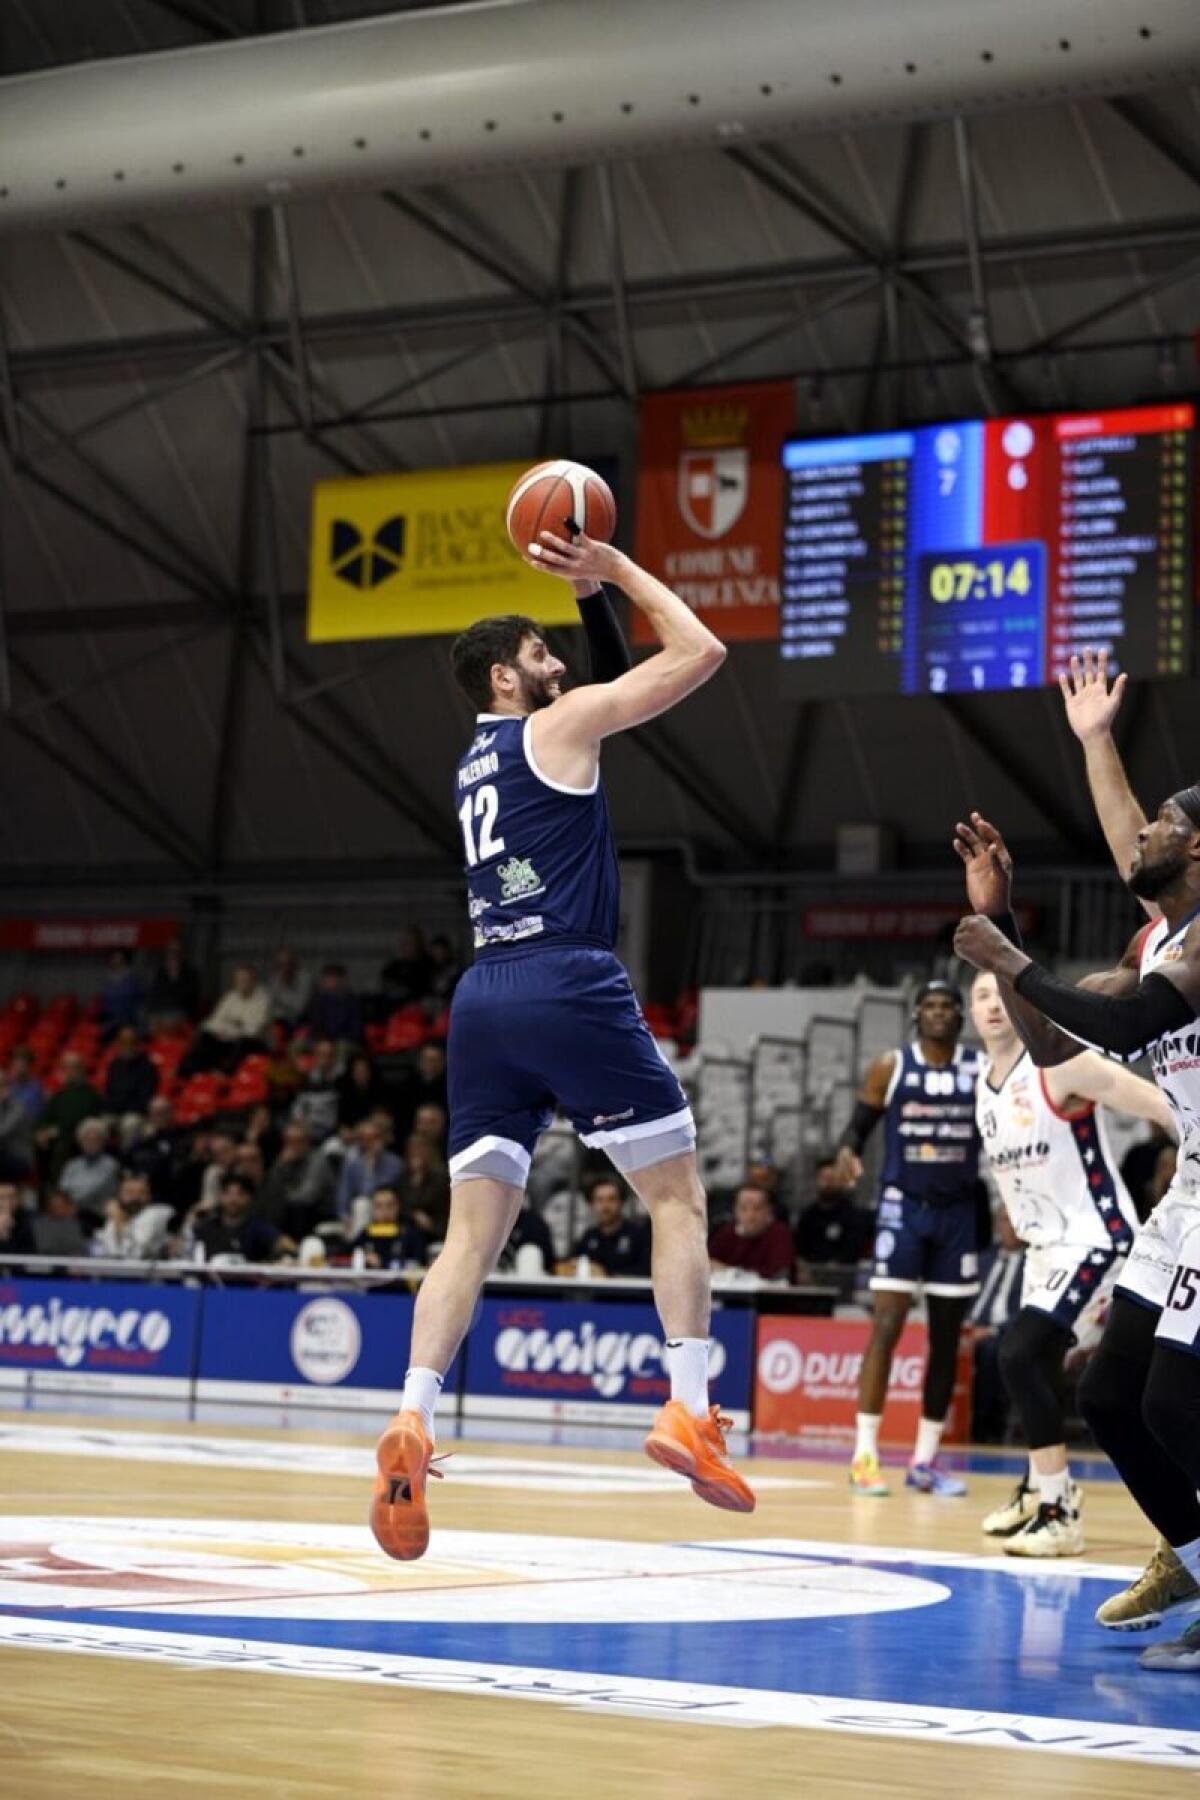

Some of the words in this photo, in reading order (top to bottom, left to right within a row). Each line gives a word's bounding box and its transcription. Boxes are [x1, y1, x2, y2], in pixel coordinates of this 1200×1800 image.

[930, 557, 1031, 602] 07:14
[459, 785, 505, 867] 12
[1167, 1264, 1200, 1311] 15
